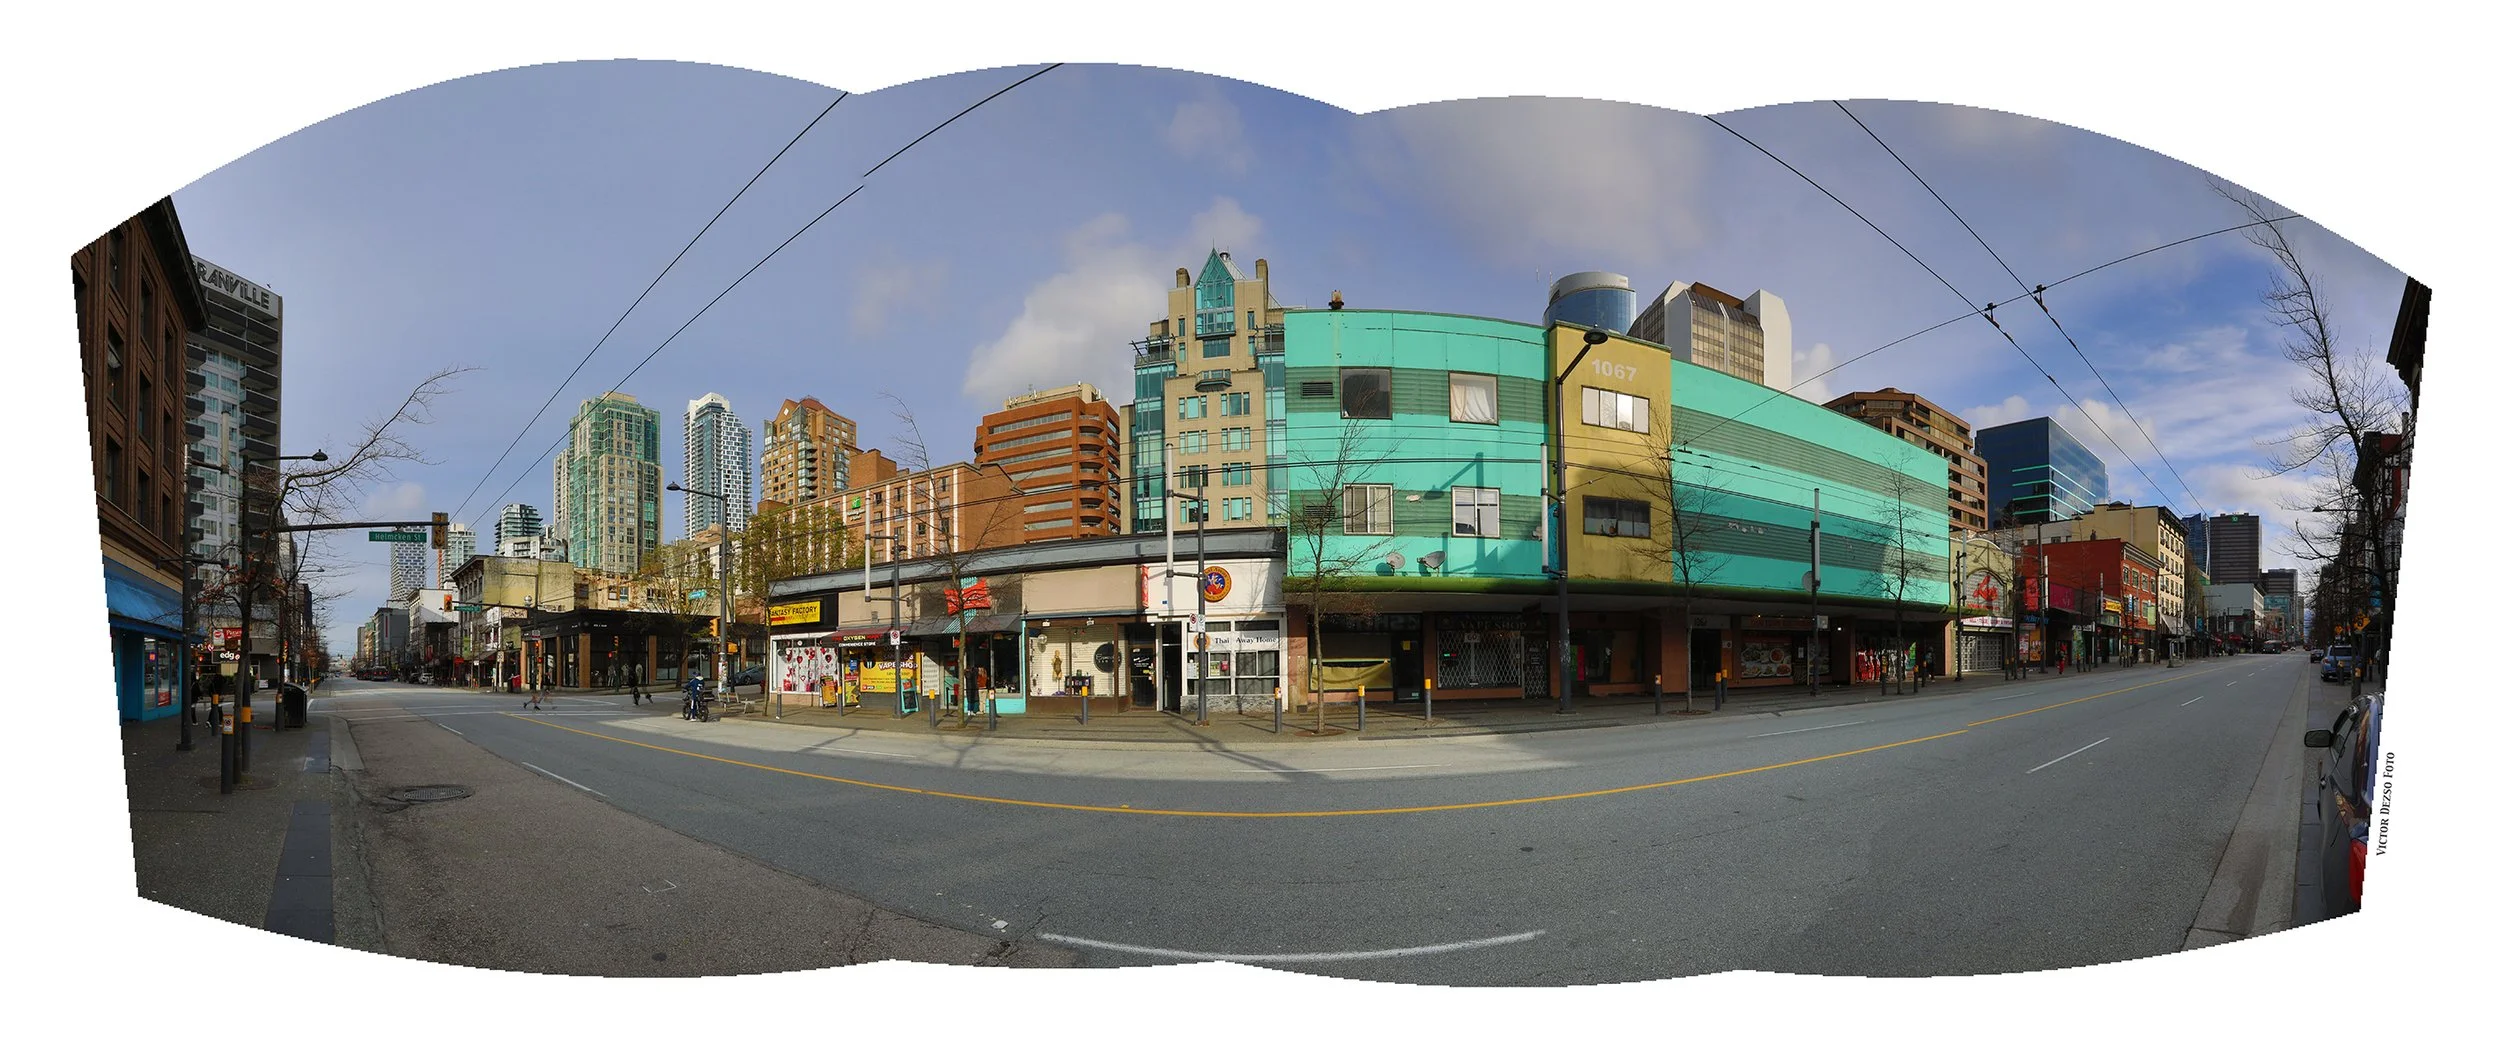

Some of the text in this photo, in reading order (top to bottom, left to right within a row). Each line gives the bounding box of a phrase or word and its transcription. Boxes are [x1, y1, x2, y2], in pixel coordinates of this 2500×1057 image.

[1591, 358, 1637, 382] 1067
[375, 533, 421, 541] Helmcken St
[792, 605, 818, 615] FACTORY
[1235, 636, 1254, 644] Away
